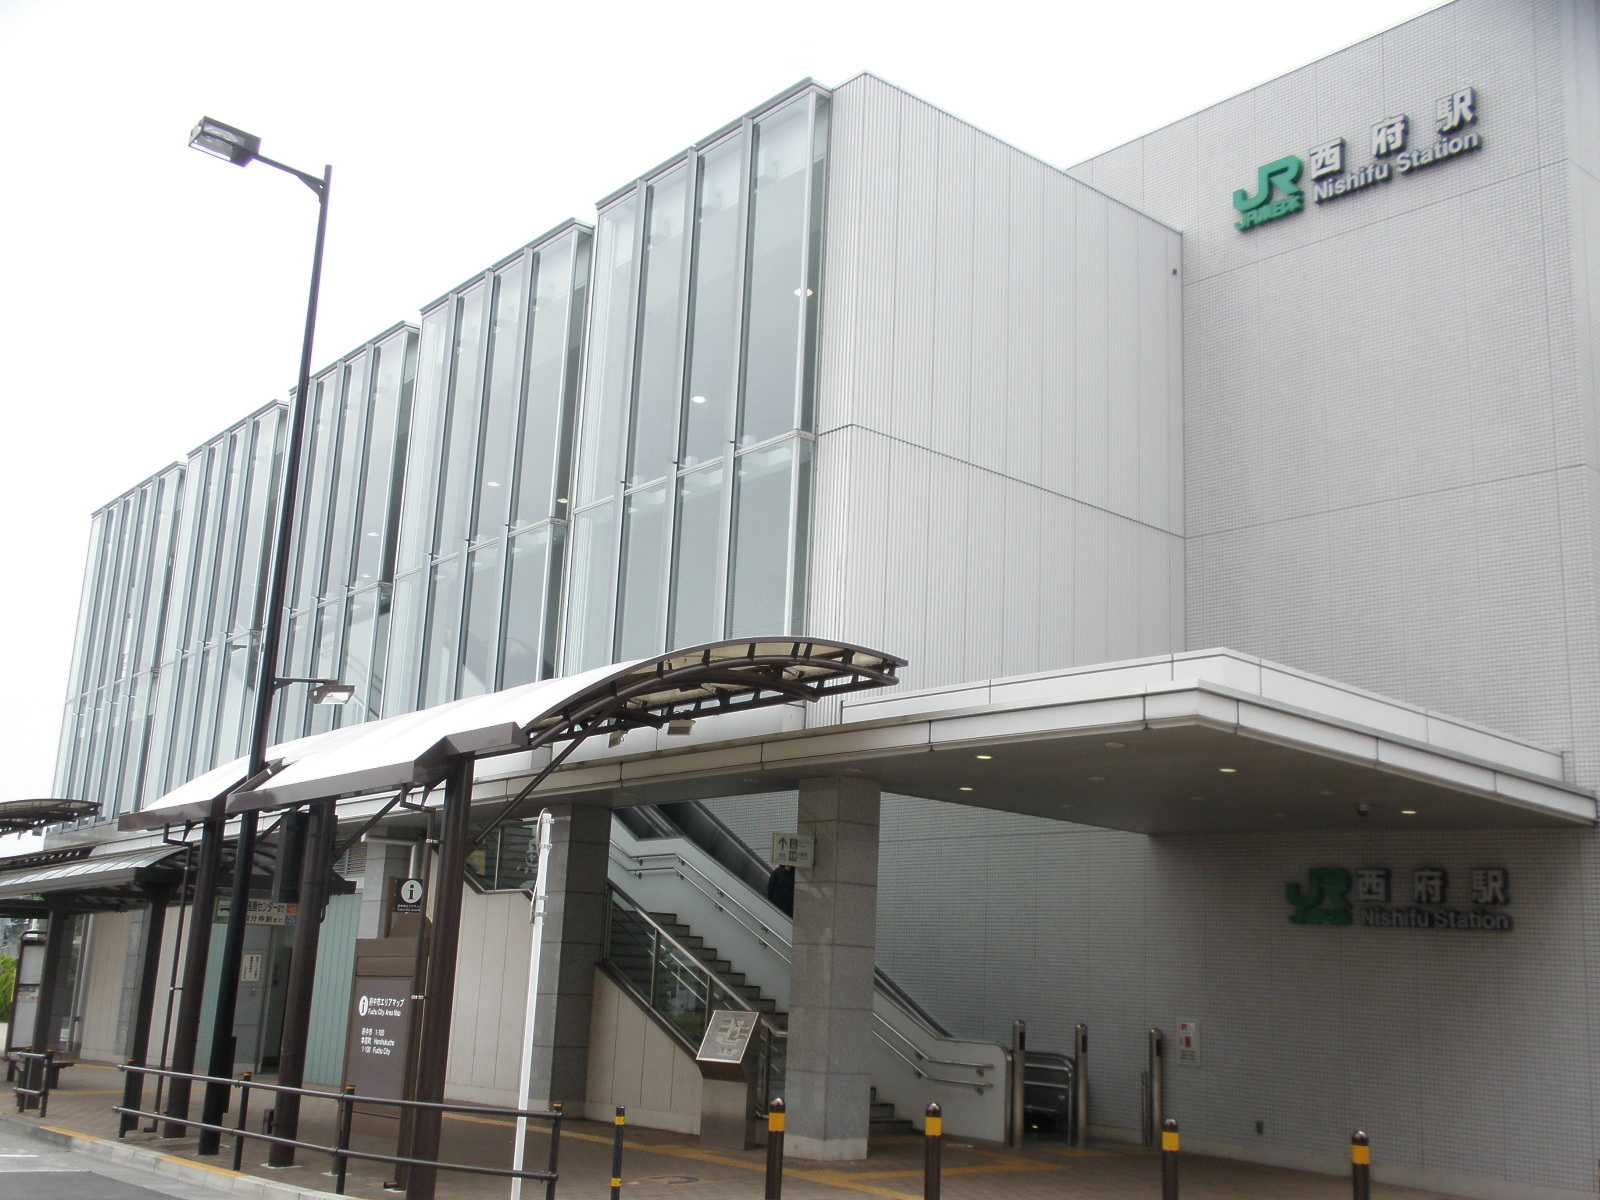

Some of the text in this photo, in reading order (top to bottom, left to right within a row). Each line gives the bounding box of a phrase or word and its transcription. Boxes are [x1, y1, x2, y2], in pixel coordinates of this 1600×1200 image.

[1309, 86, 1476, 181] 西府駅
[1232, 154, 1304, 213] JR
[1313, 131, 1482, 205] Nishifu Station
[1286, 867, 1352, 908] JR
[1356, 867, 1509, 905] 西府駅
[1360, 906, 1430, 928] Nishifu
[1433, 908, 1513, 931] Station
